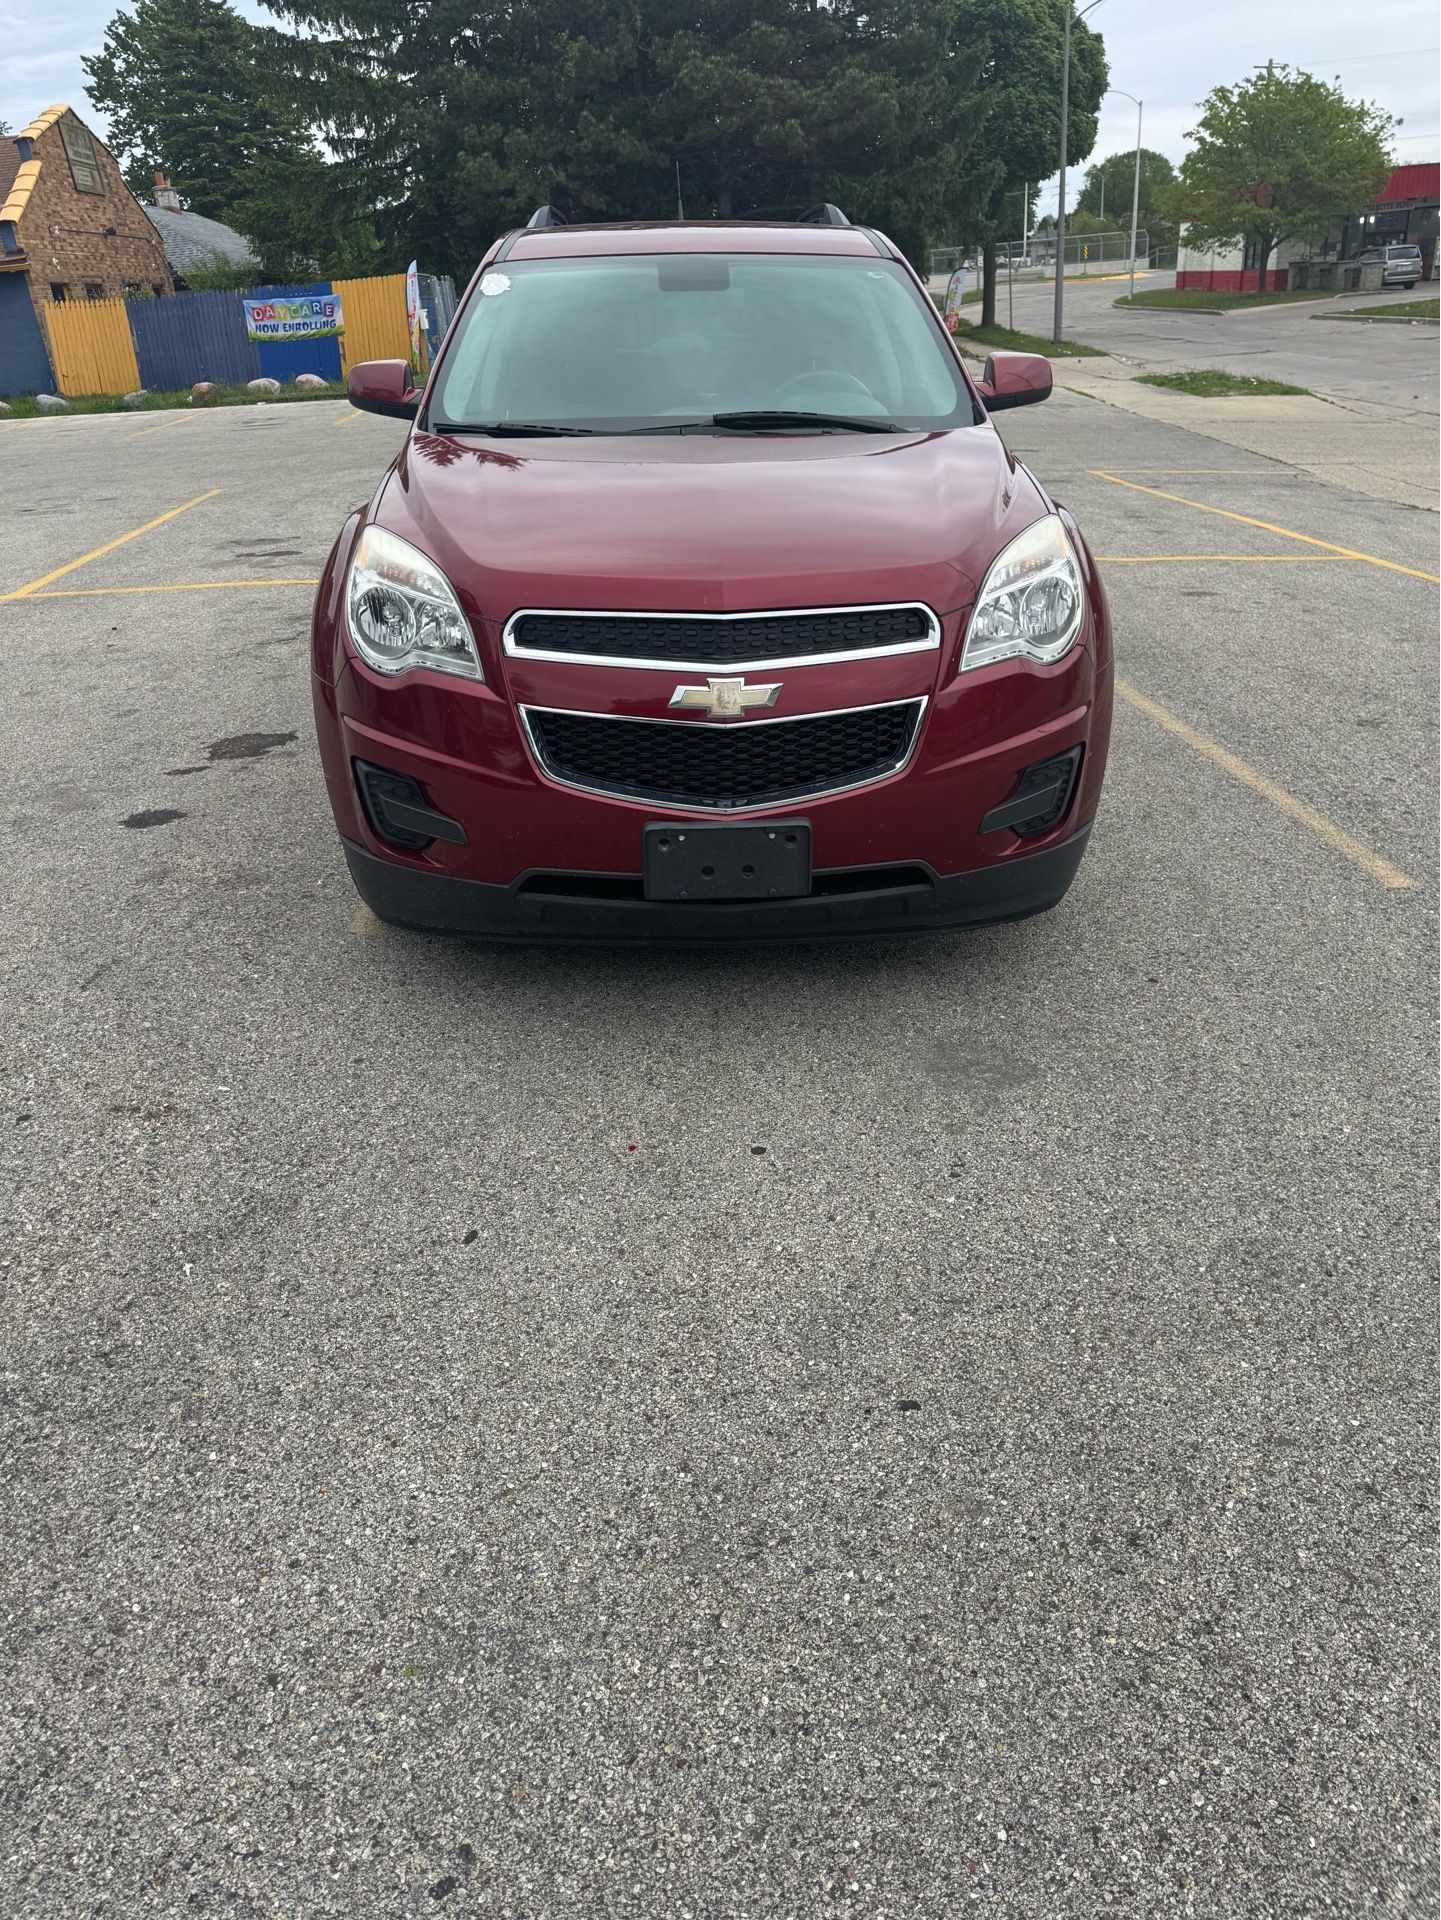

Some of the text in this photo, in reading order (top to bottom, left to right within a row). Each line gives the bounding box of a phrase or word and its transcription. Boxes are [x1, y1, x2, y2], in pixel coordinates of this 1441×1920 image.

[254, 302, 333, 319] DAYCARE
[255, 319, 336, 333] NOW ENROLLING
